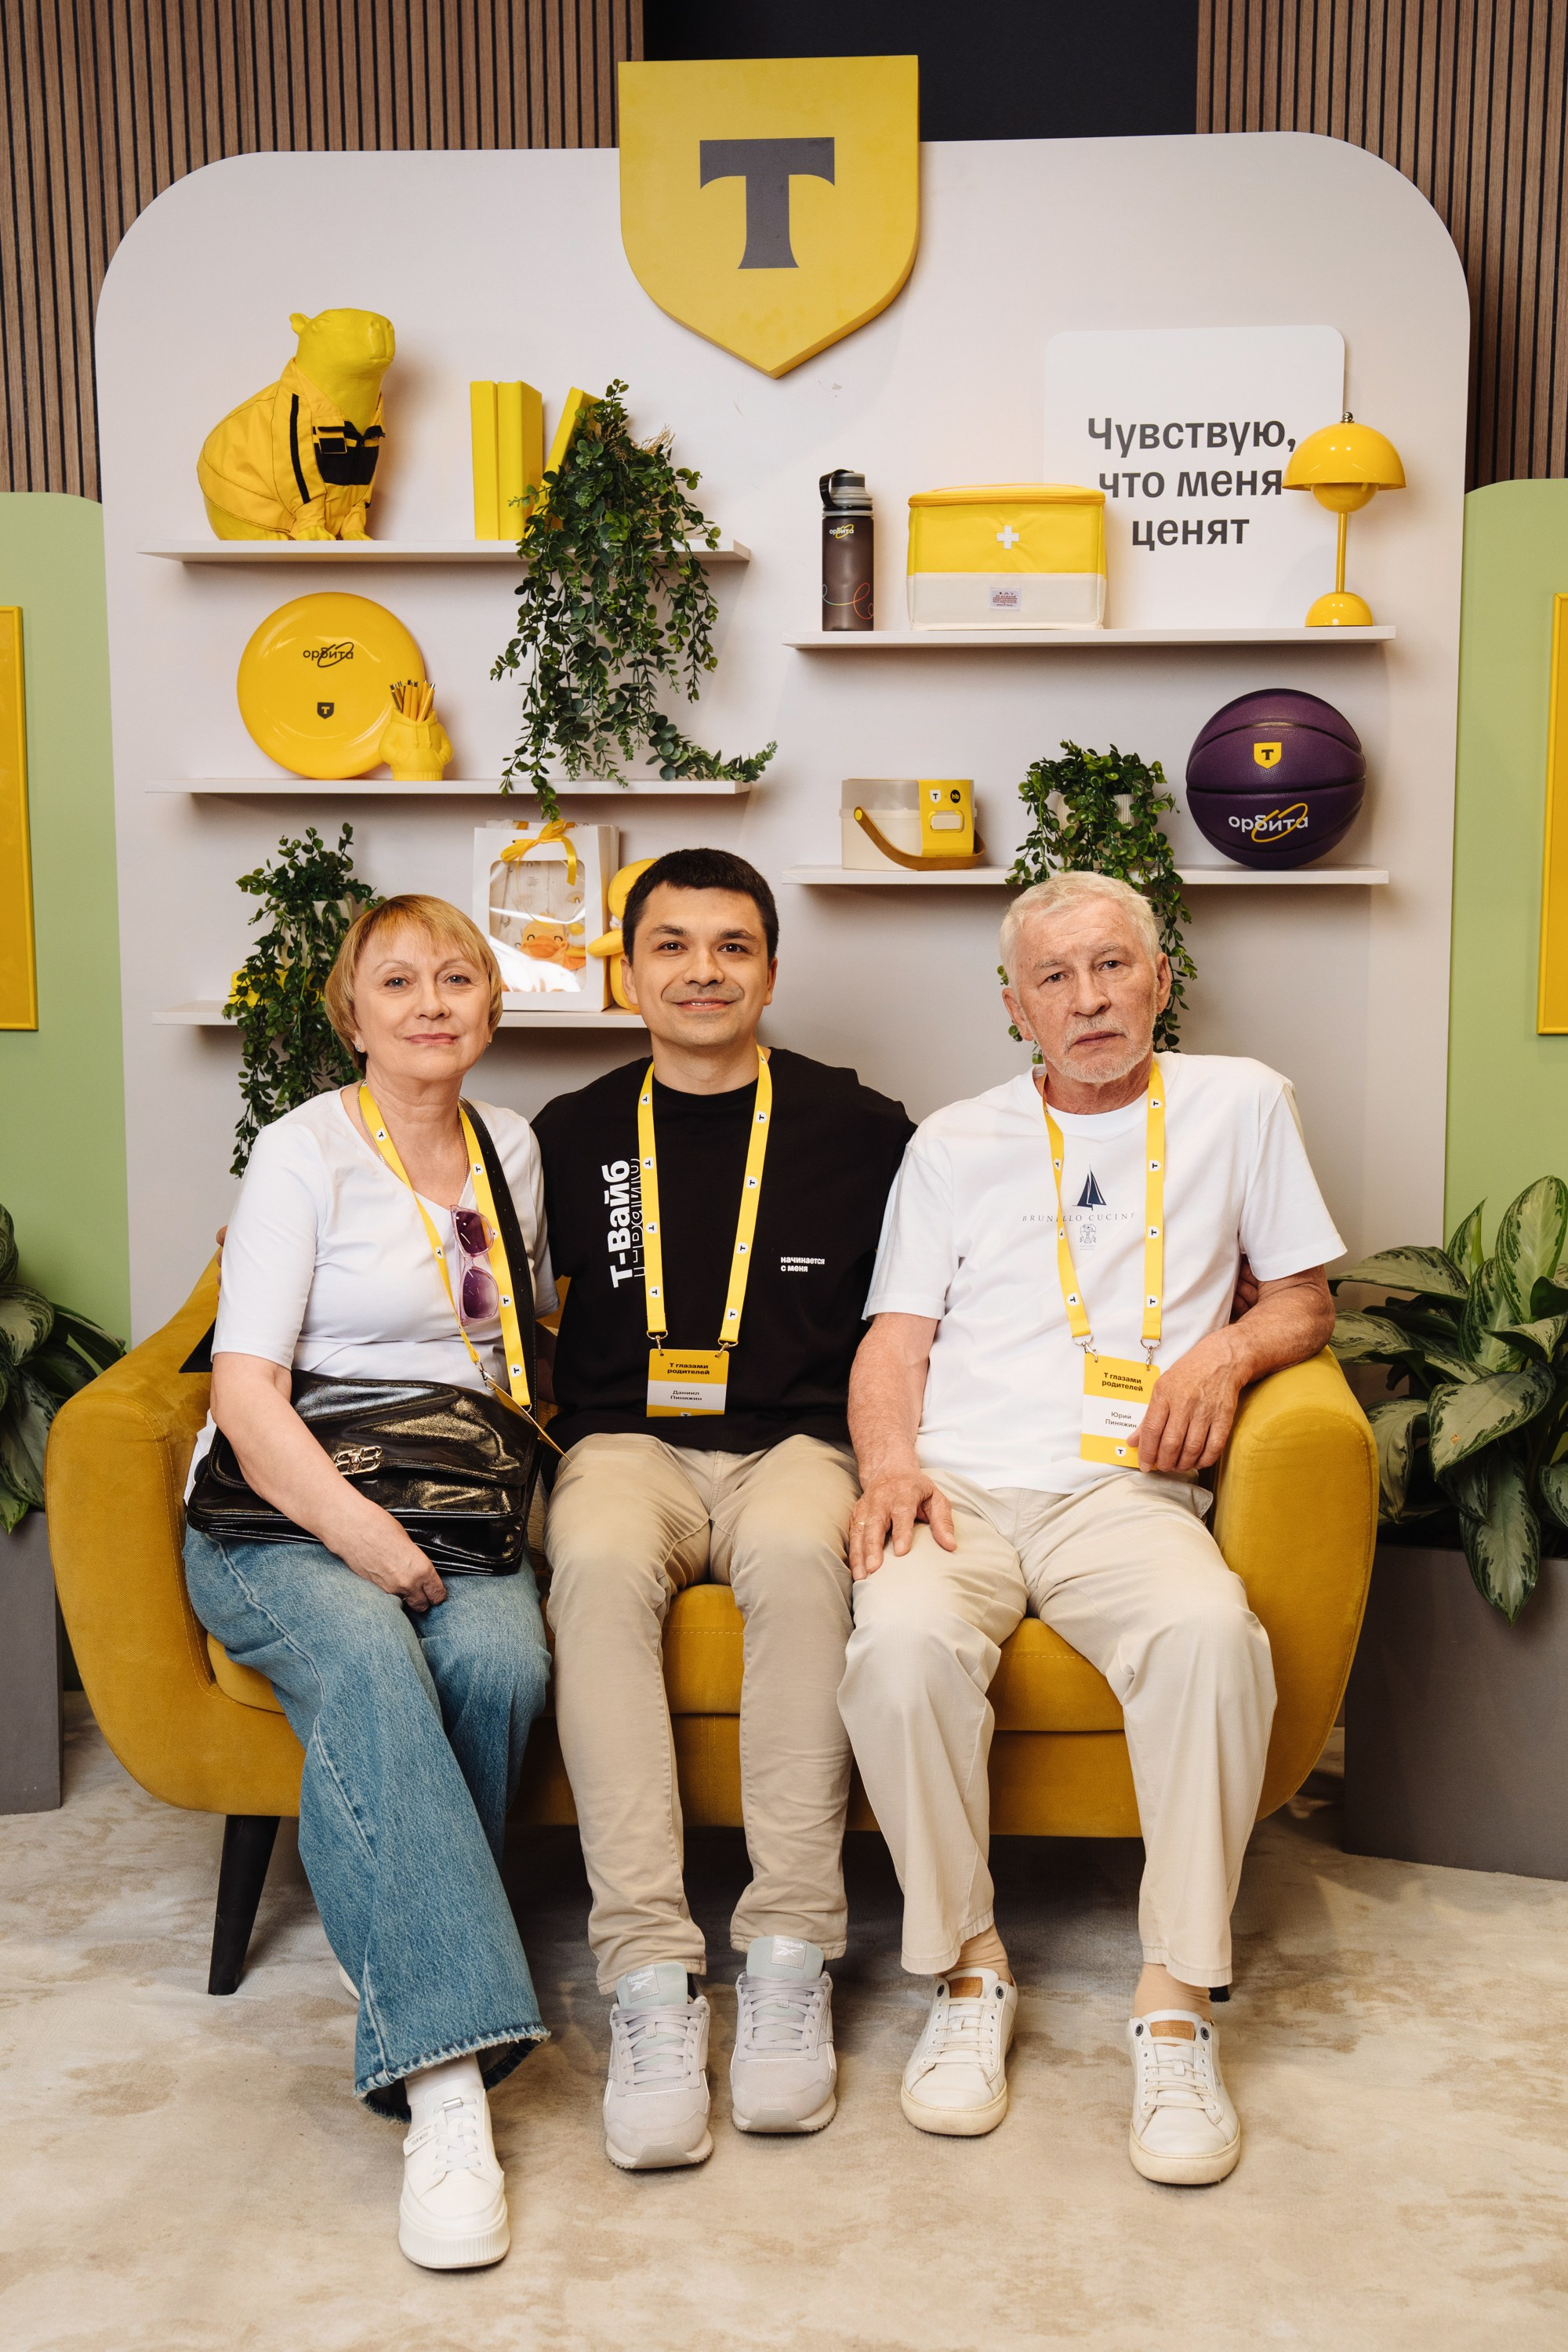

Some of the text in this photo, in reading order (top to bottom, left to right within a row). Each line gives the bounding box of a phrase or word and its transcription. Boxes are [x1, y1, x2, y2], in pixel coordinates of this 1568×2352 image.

[699, 137, 835, 269] Т
[1088, 418, 1296, 458] Чувствую,
[1099, 469, 1283, 499] что меня
[1132, 518, 1250, 551] ценят
[303, 647, 354, 661] орбита
[1229, 815, 1308, 833] орбита
[601, 1160, 633, 1288] Т-Вайб
[1102, 1381, 1143, 1392] родителей
[1110, 1374, 1142, 1384] глазами
[1105, 1419, 1137, 1428] Пиняжин
[775, 1938, 804, 1949] Reebok
[627, 1969, 654, 1983] Reebok
